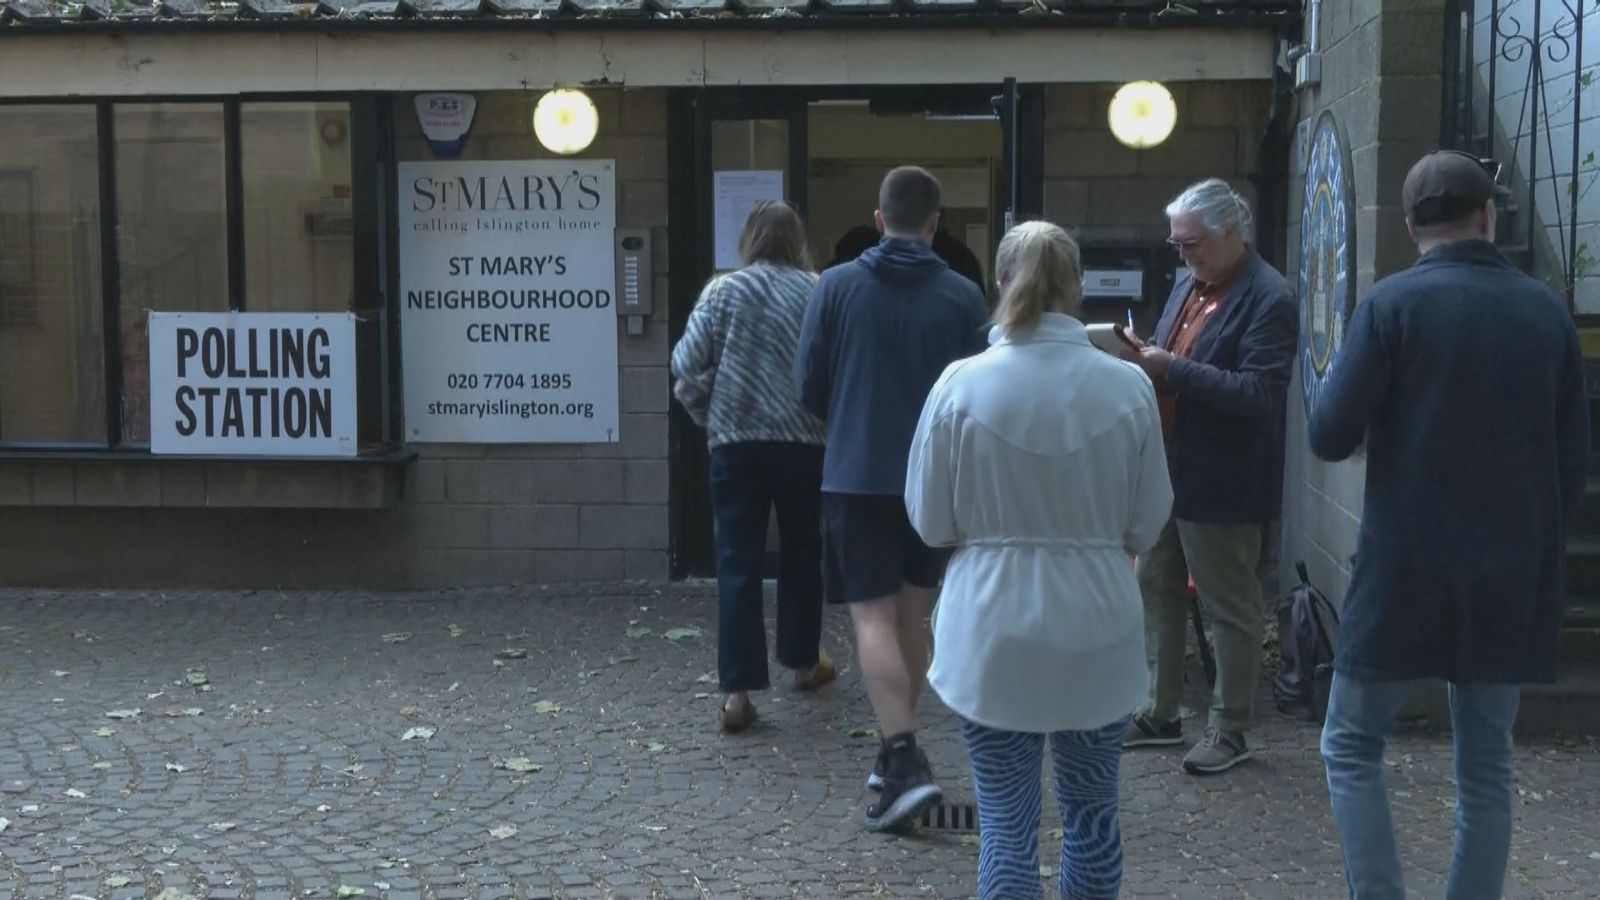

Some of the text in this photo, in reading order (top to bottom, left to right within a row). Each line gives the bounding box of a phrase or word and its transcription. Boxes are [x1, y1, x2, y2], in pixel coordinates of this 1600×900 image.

[413, 216, 601, 233] calling Islington home
[448, 255, 567, 277] ST MARY'S
[407, 289, 611, 310] NEIGHBOURHOOD
[466, 323, 551, 343] CENTRE
[176, 326, 331, 379] POLLING
[447, 373, 572, 390] 020 7704 1895
[175, 385, 332, 439] STATION
[427, 400, 594, 419] stmaryislington.org
